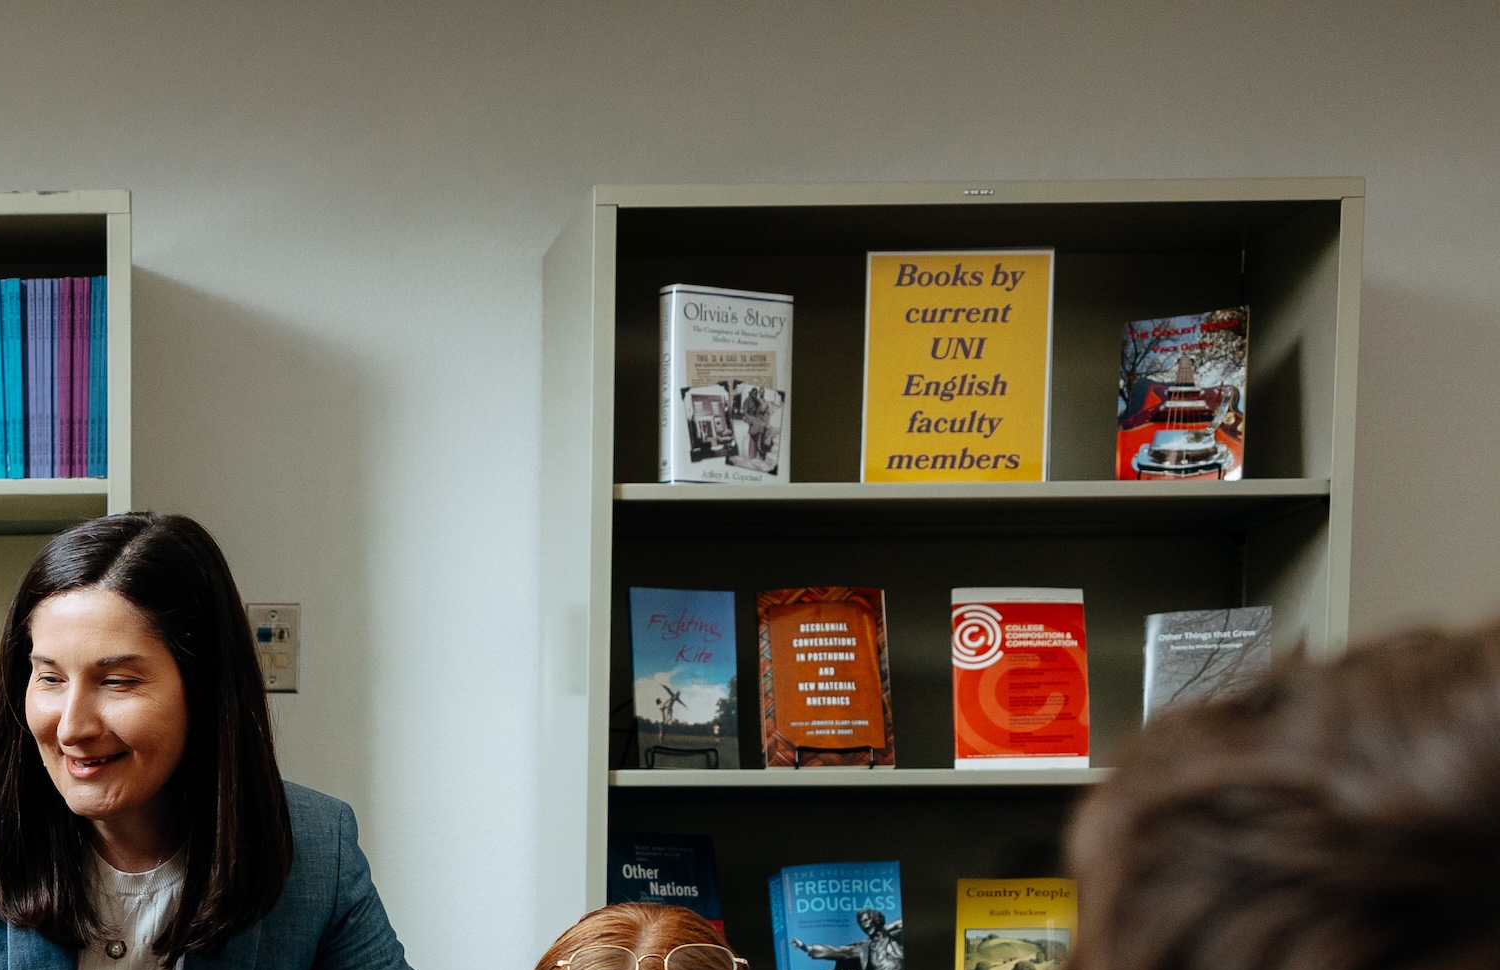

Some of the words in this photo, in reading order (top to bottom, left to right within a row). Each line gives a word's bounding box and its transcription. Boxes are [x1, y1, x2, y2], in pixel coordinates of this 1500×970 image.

[894, 263, 984, 287] Books
[991, 263, 1026, 292] by
[683, 302, 738, 323] Olivia's
[744, 307, 787, 336] Story
[905, 303, 1012, 323] current
[930, 337, 988, 360] UNI
[902, 373, 1008, 401] English
[906, 410, 1003, 438] faculty
[886, 447, 1020, 470] members
[647, 608, 723, 643] Fighting
[799, 623, 848, 632] DECOLONIAL
[792, 637, 857, 648] CONVERSATIONS
[1158, 633, 1183, 641] Other
[1184, 630, 1212, 641] Things
[1213, 629, 1231, 638] that
[1232, 629, 1257, 637] Grow
[1005, 640, 1078, 648] COMMUNICATION
[675, 645, 713, 663] Kite
[796, 653, 806, 662] IN
[807, 652, 855, 662] POSTHUMAN
[818, 667, 835, 676] AND
[798, 682, 816, 691] NEW
[818, 681, 856, 691] MATERIAL
[806, 696, 851, 706] RHETORICS
[622, 864, 659, 879] Other
[649, 882, 699, 897] Nations
[794, 879, 894, 896] FREDERICK
[966, 887, 1021, 900] Country
[1026, 887, 1071, 899] People
[796, 896, 896, 913] DOUGLASS
